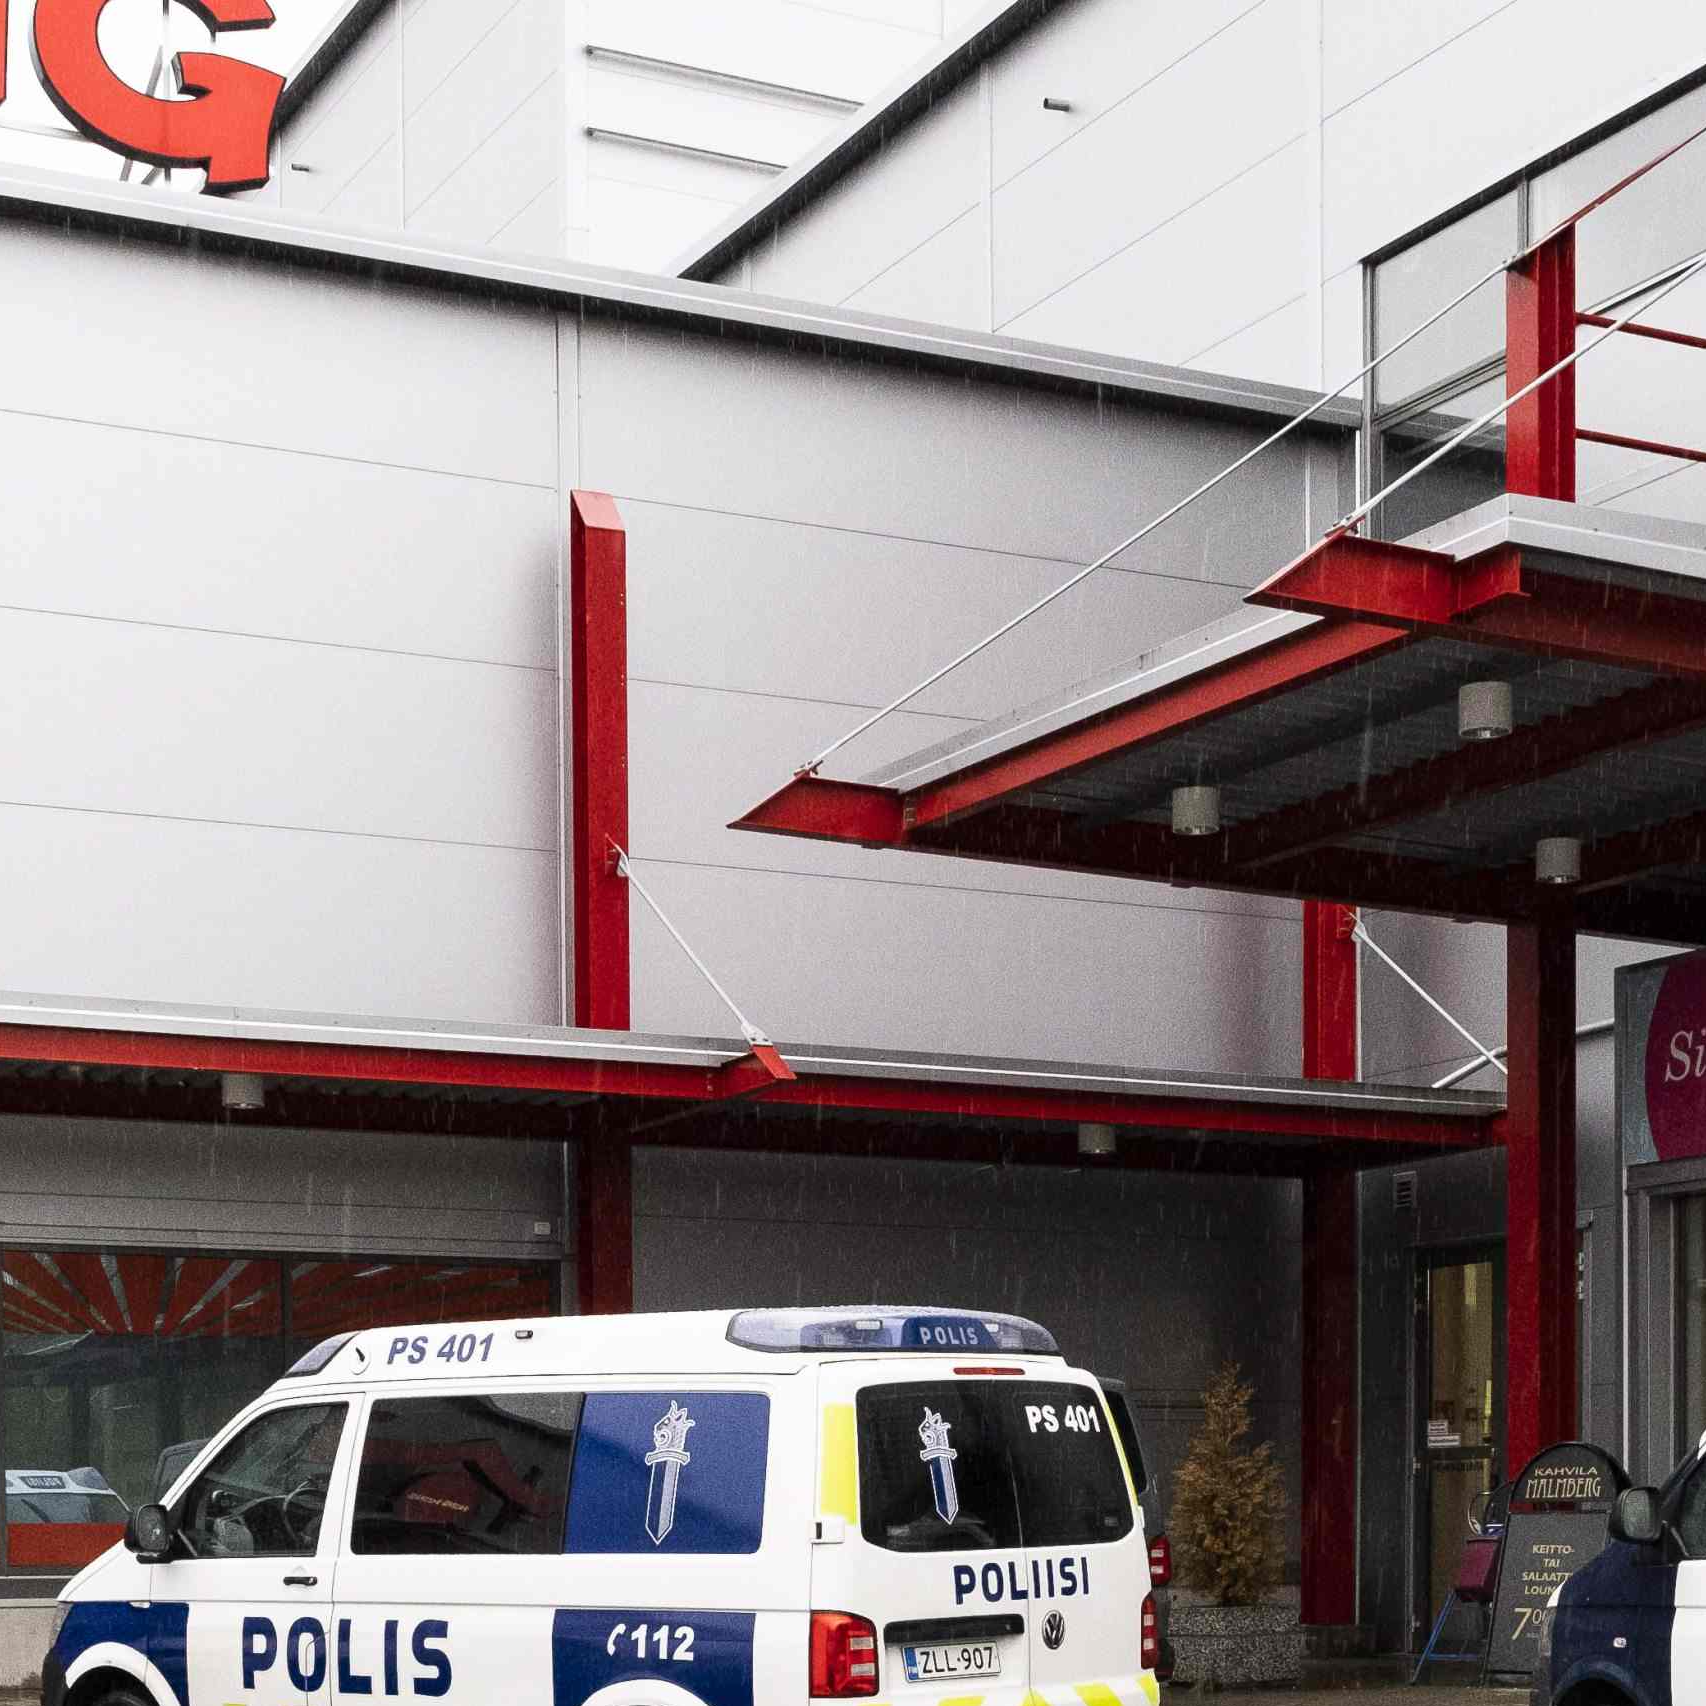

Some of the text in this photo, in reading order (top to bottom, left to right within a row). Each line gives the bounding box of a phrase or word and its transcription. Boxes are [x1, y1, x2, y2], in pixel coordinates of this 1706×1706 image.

[386, 1332, 495, 1366] PS 401
[918, 1325, 980, 1346] POLIS
[1024, 1403, 1102, 1434] PS 401
[1534, 1466, 1599, 1477] KAHVILA
[1524, 1476, 1603, 1500] MALMBERG
[1531, 1544, 1574, 1555] KEITTO-
[1542, 1559, 1561, 1568] TAI
[952, 1555, 1090, 1605] POLIISI
[629, 1622, 696, 1661] 112
[241, 1615, 454, 1698] POLIS
